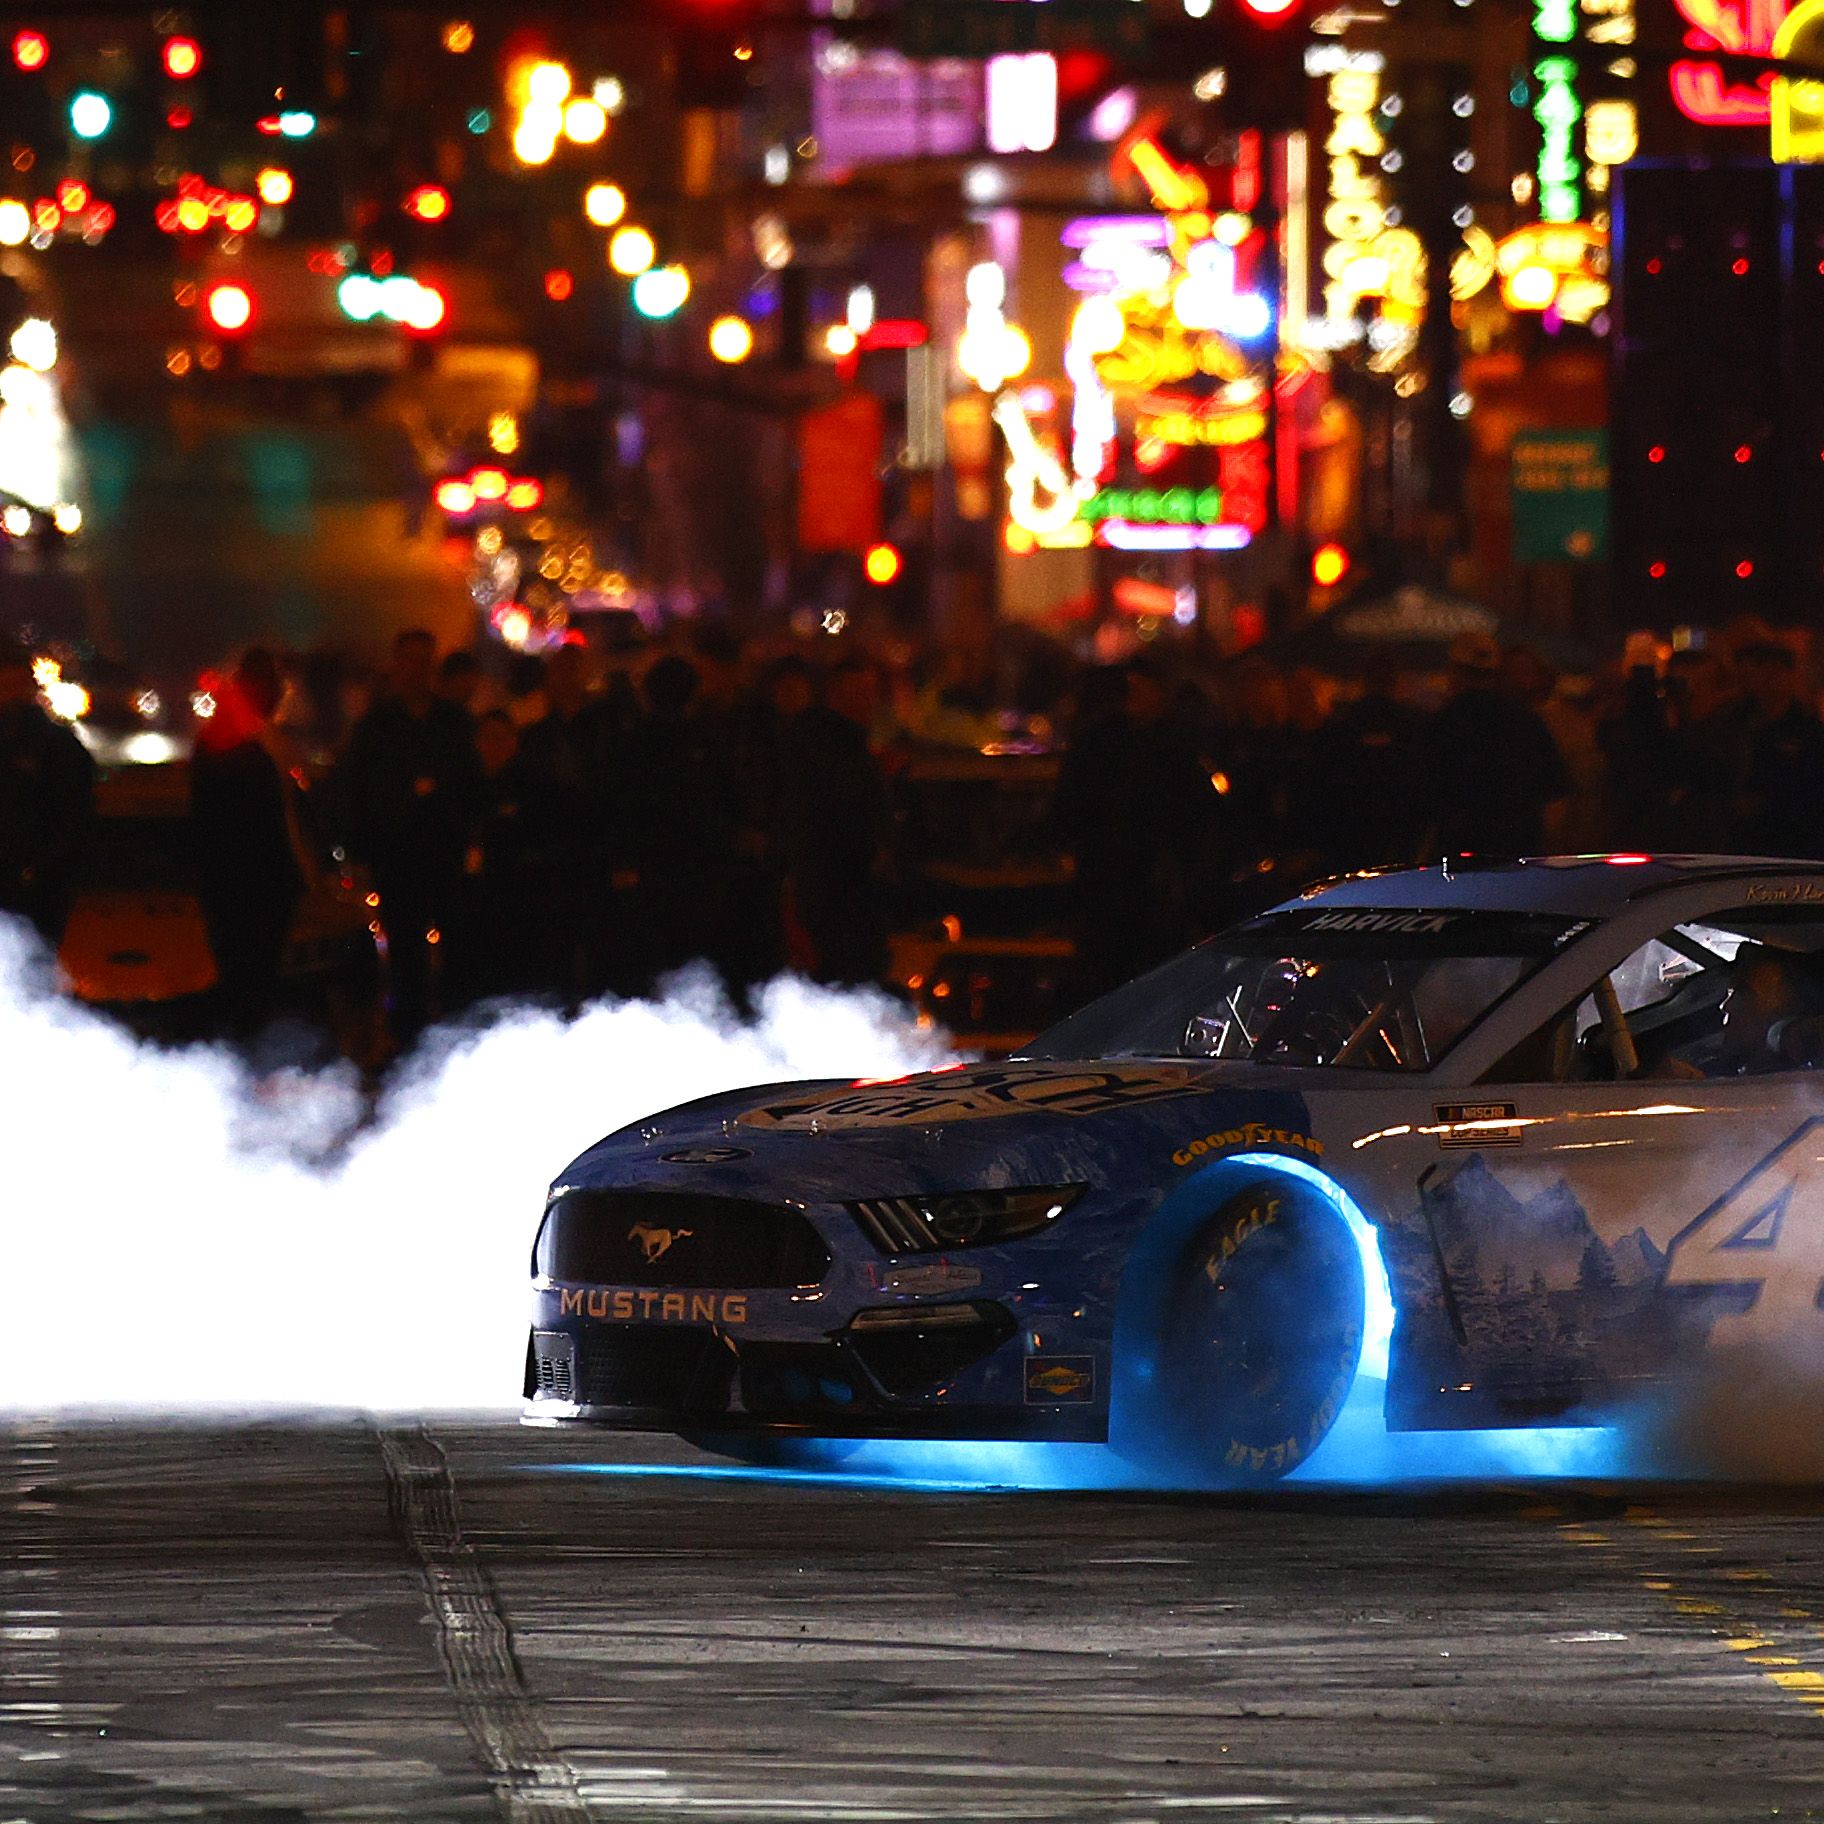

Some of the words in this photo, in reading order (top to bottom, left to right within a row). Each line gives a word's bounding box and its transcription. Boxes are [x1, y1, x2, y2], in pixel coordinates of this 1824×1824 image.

[1302, 913, 1456, 933] HARVICK
[1172, 1122, 1325, 1166] GOODYEAR
[560, 1288, 749, 1323] MUSTANG
